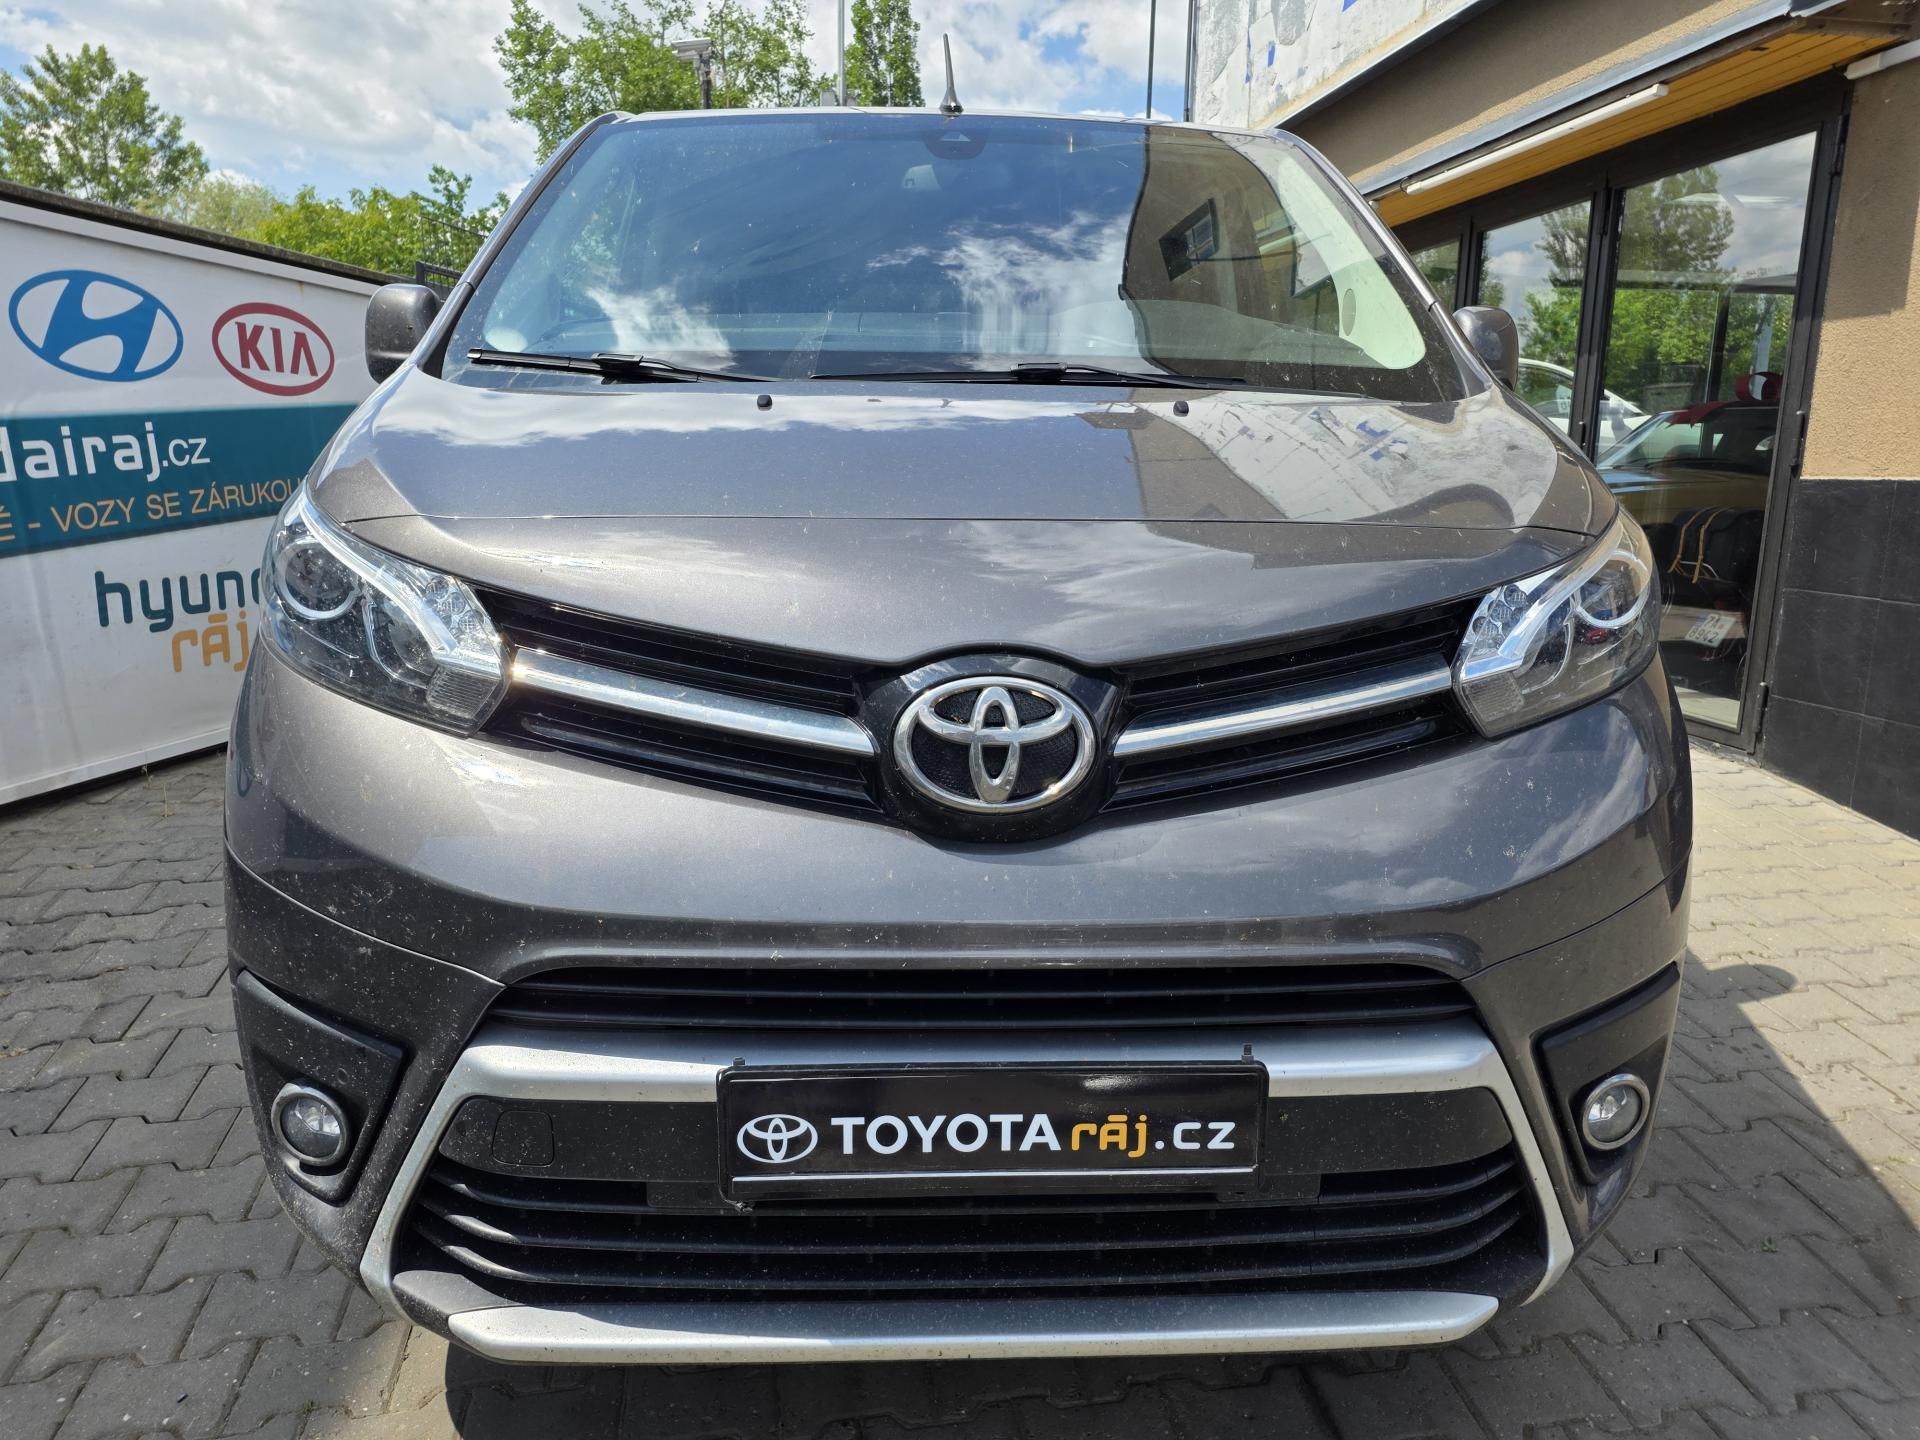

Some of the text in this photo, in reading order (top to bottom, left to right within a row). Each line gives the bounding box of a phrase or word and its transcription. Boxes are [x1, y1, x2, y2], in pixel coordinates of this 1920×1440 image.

[234, 320, 318, 377] KIA
[51, 497, 135, 533] VOZY
[146, 491, 182, 519] SE
